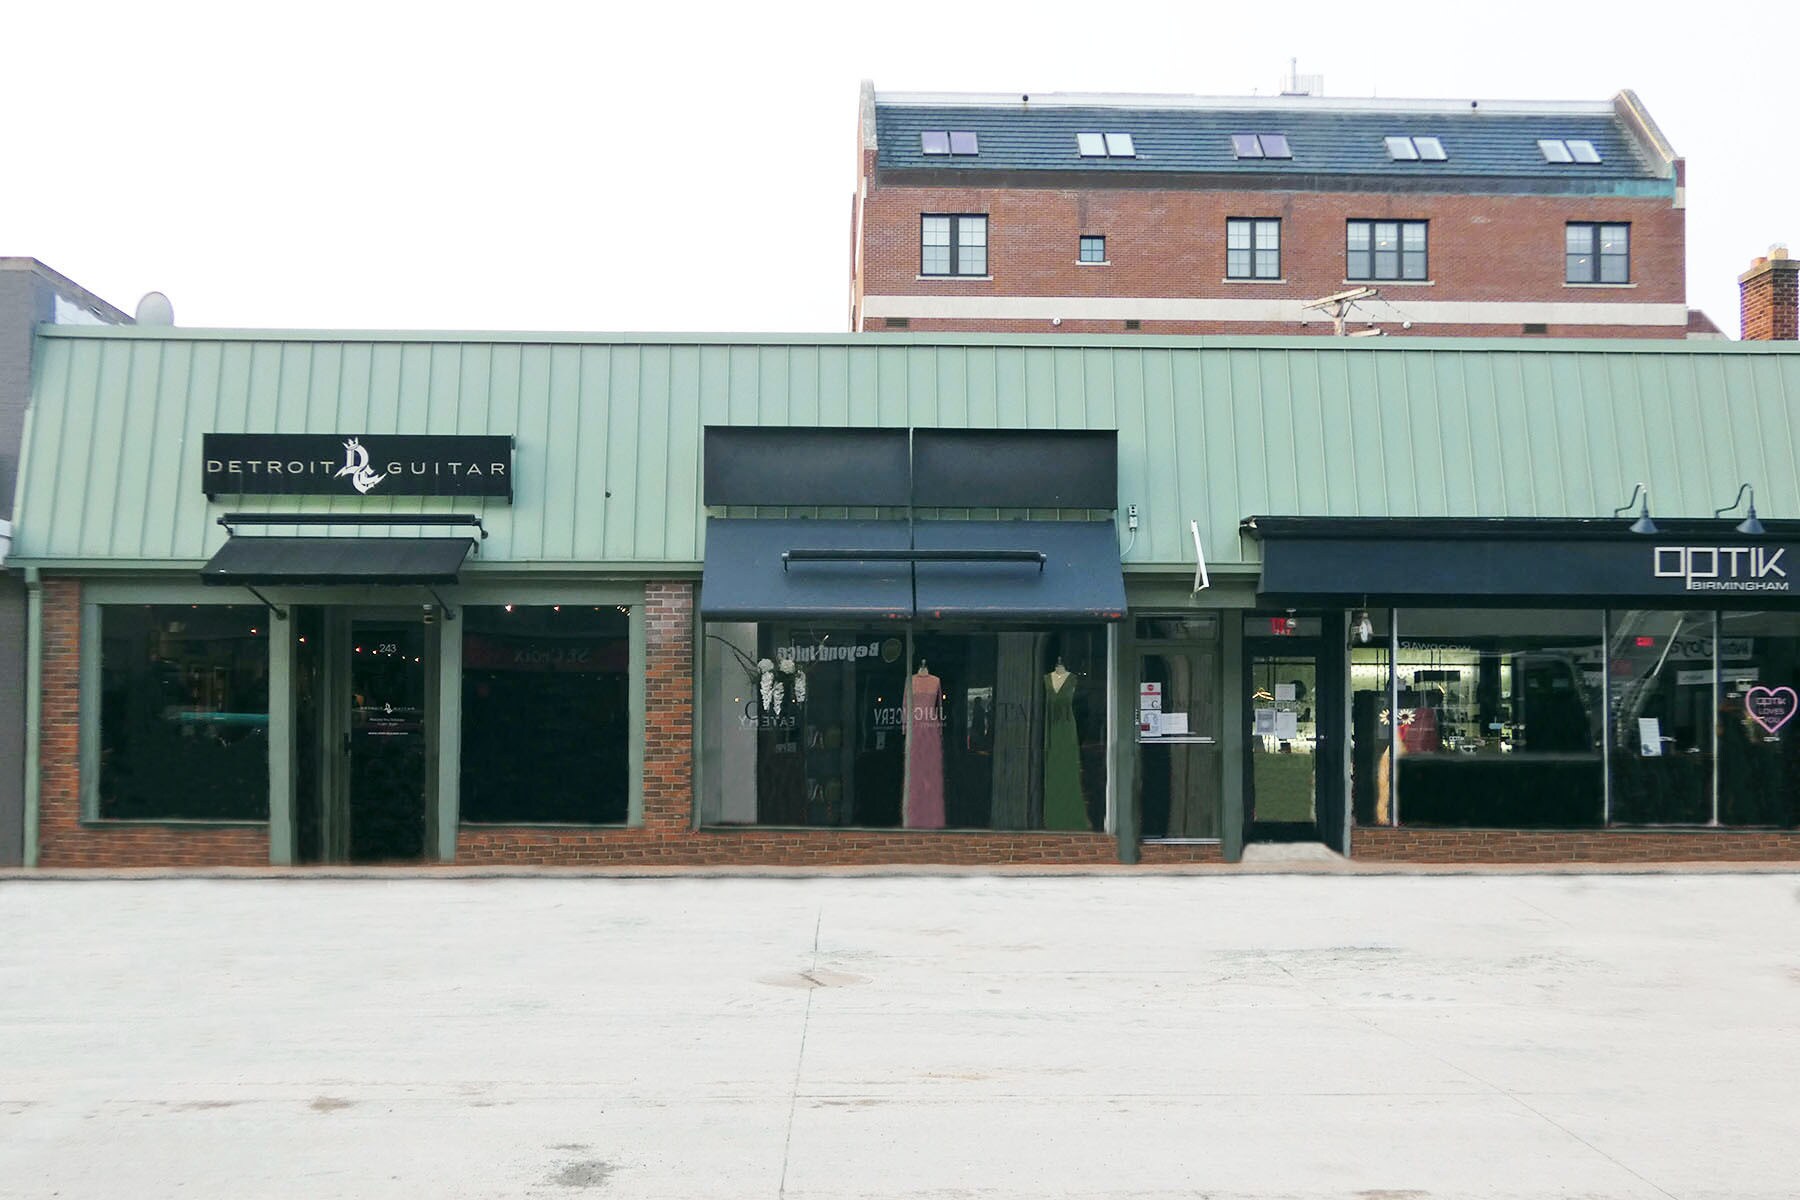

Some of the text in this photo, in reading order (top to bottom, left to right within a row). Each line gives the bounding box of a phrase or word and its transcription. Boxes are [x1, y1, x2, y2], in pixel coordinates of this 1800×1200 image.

[207, 460, 335, 474] DETROIT
[387, 461, 505, 475] GUITAR
[1654, 546, 1787, 590] OPTIK
[1692, 581, 1789, 591] BIRMINGHAM
[379, 643, 397, 653] 243
